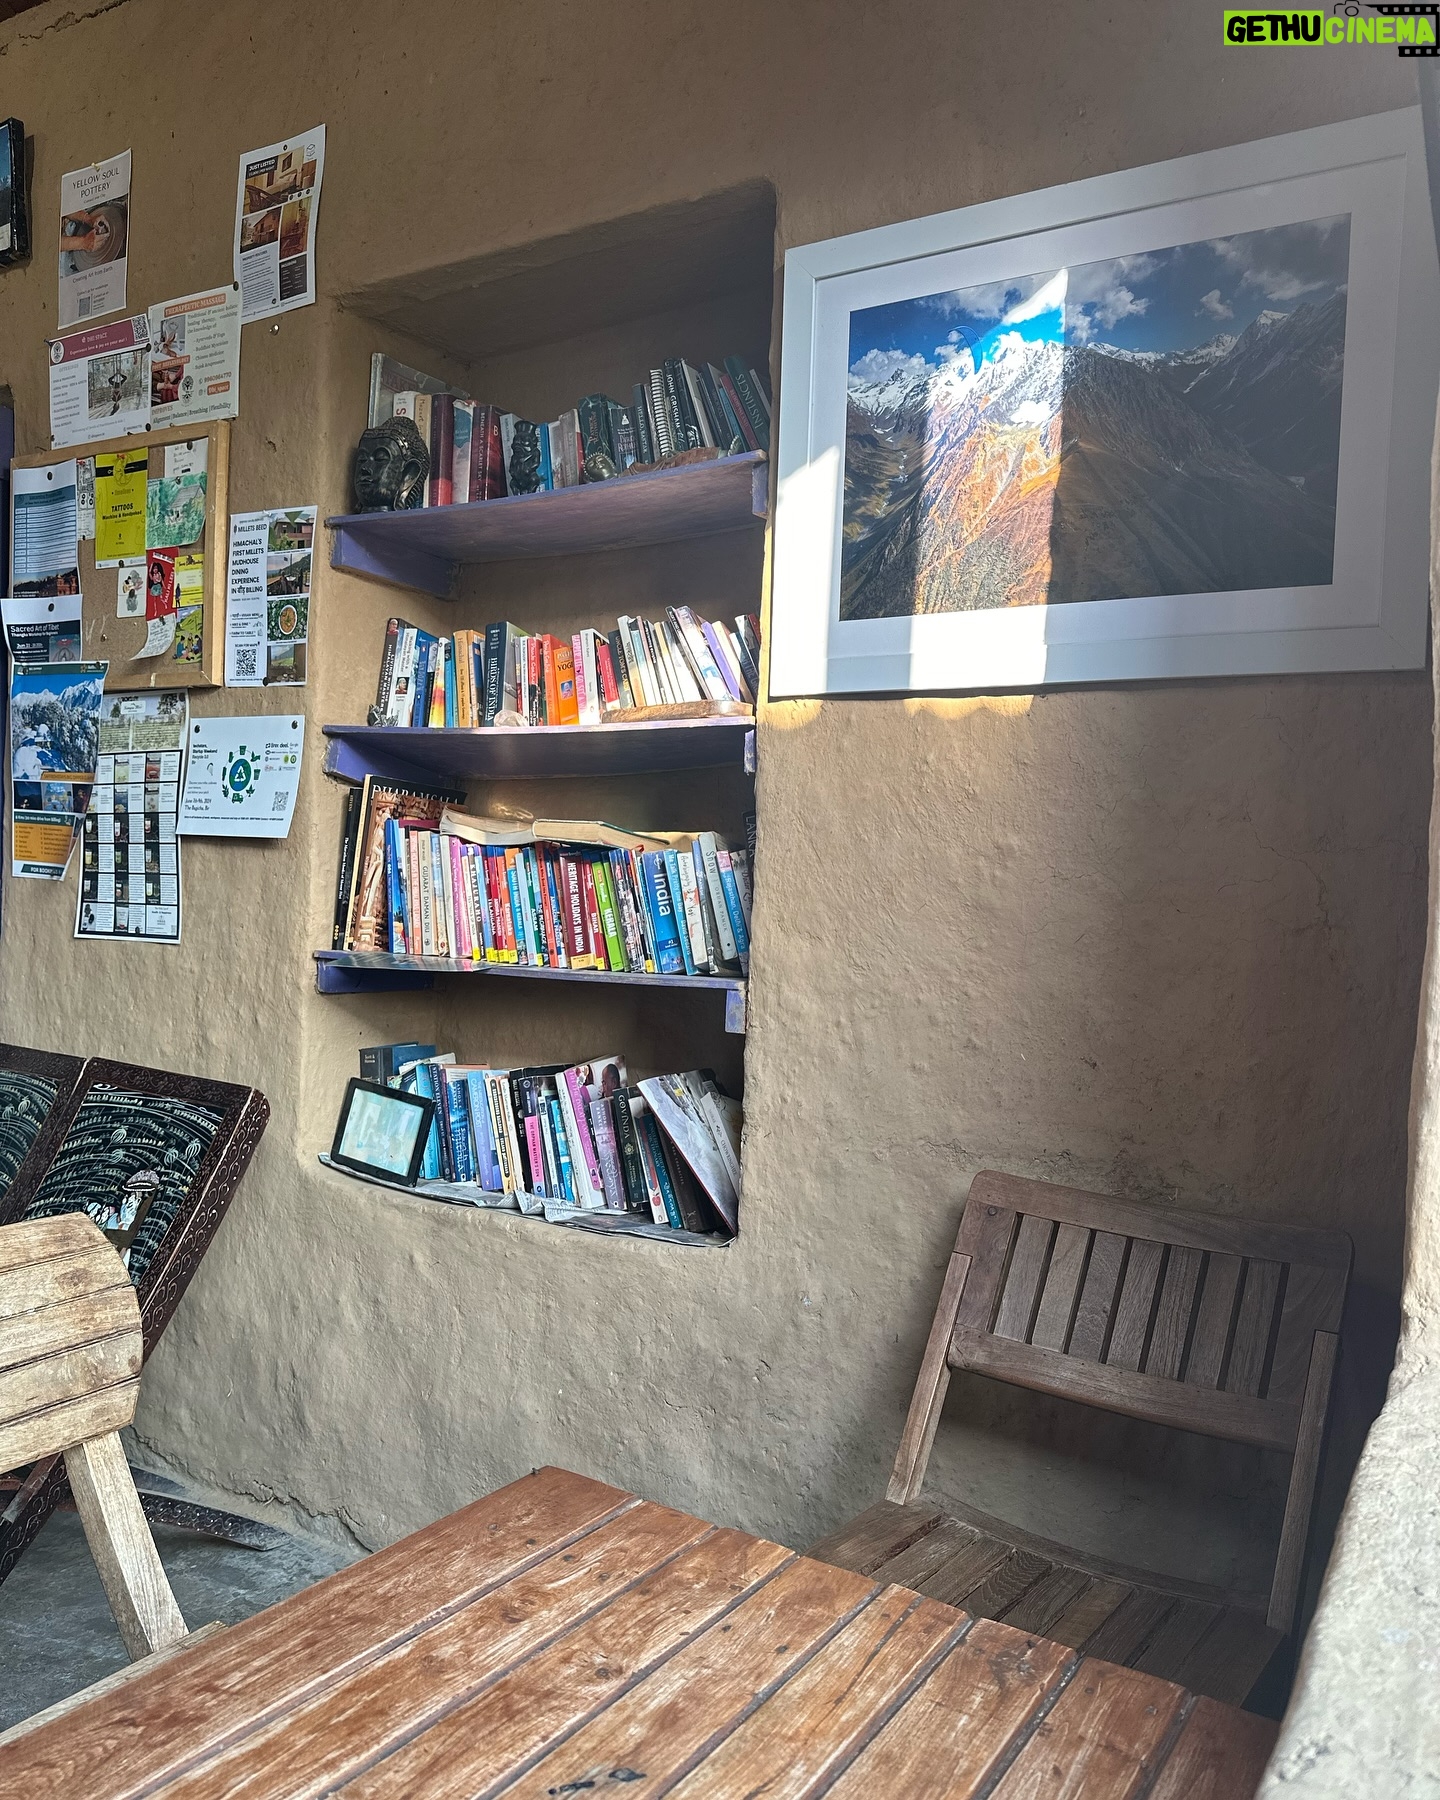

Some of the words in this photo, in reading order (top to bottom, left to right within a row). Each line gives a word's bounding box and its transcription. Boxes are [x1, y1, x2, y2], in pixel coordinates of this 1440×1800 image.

[260, 160, 275, 168] LISTED
[72, 173, 100, 190] YELLOW
[102, 167, 120, 180] SOUL
[80, 182, 111, 198] POTTERY
[165, 301, 200, 316] THERAPEUTIC
[200, 295, 226, 308] MASSAGE
[666, 373, 675, 393] JOHN
[210, 402, 231, 412] Flexibility
[670, 395, 682, 430] GRISHAM
[735, 373, 764, 429] INSTINCTS
[111, 503, 134, 512] TATTOOS
[238, 524, 256, 533] MILLETS
[232, 538, 262, 547] HIMACHAL'S
[232, 549, 245, 557] FIRST
[232, 558, 259, 566] MUDHOUSE
[231, 577, 260, 585] EXPERIENCE
[246, 586, 263, 594] BILLING
[10, 625, 34, 633] Sacred
[401, 632, 410, 656] Himalayan
[406, 636, 414, 654] Walking
[457, 638, 465, 664] Himachal
[615, 636, 623, 655] UNCLE
[383, 644, 393, 681] HIMALAYAN
[490, 657, 498, 683] BIRDS
[618, 655, 627, 673] TOM'S
[379, 682, 387, 712] MASTERS
[489, 683, 497, 695] OF
[487, 697, 497, 721] INDIA
[745, 815, 757, 858] LANKA
[422, 866, 430, 893] GUJARAT
[511, 870, 519, 891] SOUTH
[567, 862, 578, 893] HERITAGE
[671, 874, 680, 892] Pretty
[470, 864, 482, 922] KHAJURAHO
[653, 873, 672, 917] India
[674, 891, 682, 902] One
[705, 850, 717, 875] Snow
[714, 886, 723, 909] ORHAN
[719, 911, 728, 933] PAMUK
[488, 898, 497, 936] TELANGANA
[504, 902, 513, 937] Karnataka
[531, 908, 539, 931] ASSAM
[571, 894, 581, 925] HOLIDAYS
[725, 876, 737, 910] Rajasthan,
[732, 911, 742, 927] Delhi
[737, 934, 746, 950] Agra
[539, 914, 547, 944] PILGRIMAGE
[574, 926, 583, 934] IN
[590, 912, 599, 934] BIHAR
[603, 908, 617, 938] KERALA
[575, 934, 584, 953] INDIA
[682, 935, 691, 955] Sedaris
[431, 1066, 440, 1091] STATION
[435, 1092, 443, 1115] ELEVEN
[470, 1078, 480, 1111] CAMERON
[474, 1112, 482, 1128] POST
[618, 1094, 630, 1139] GOVINDA
